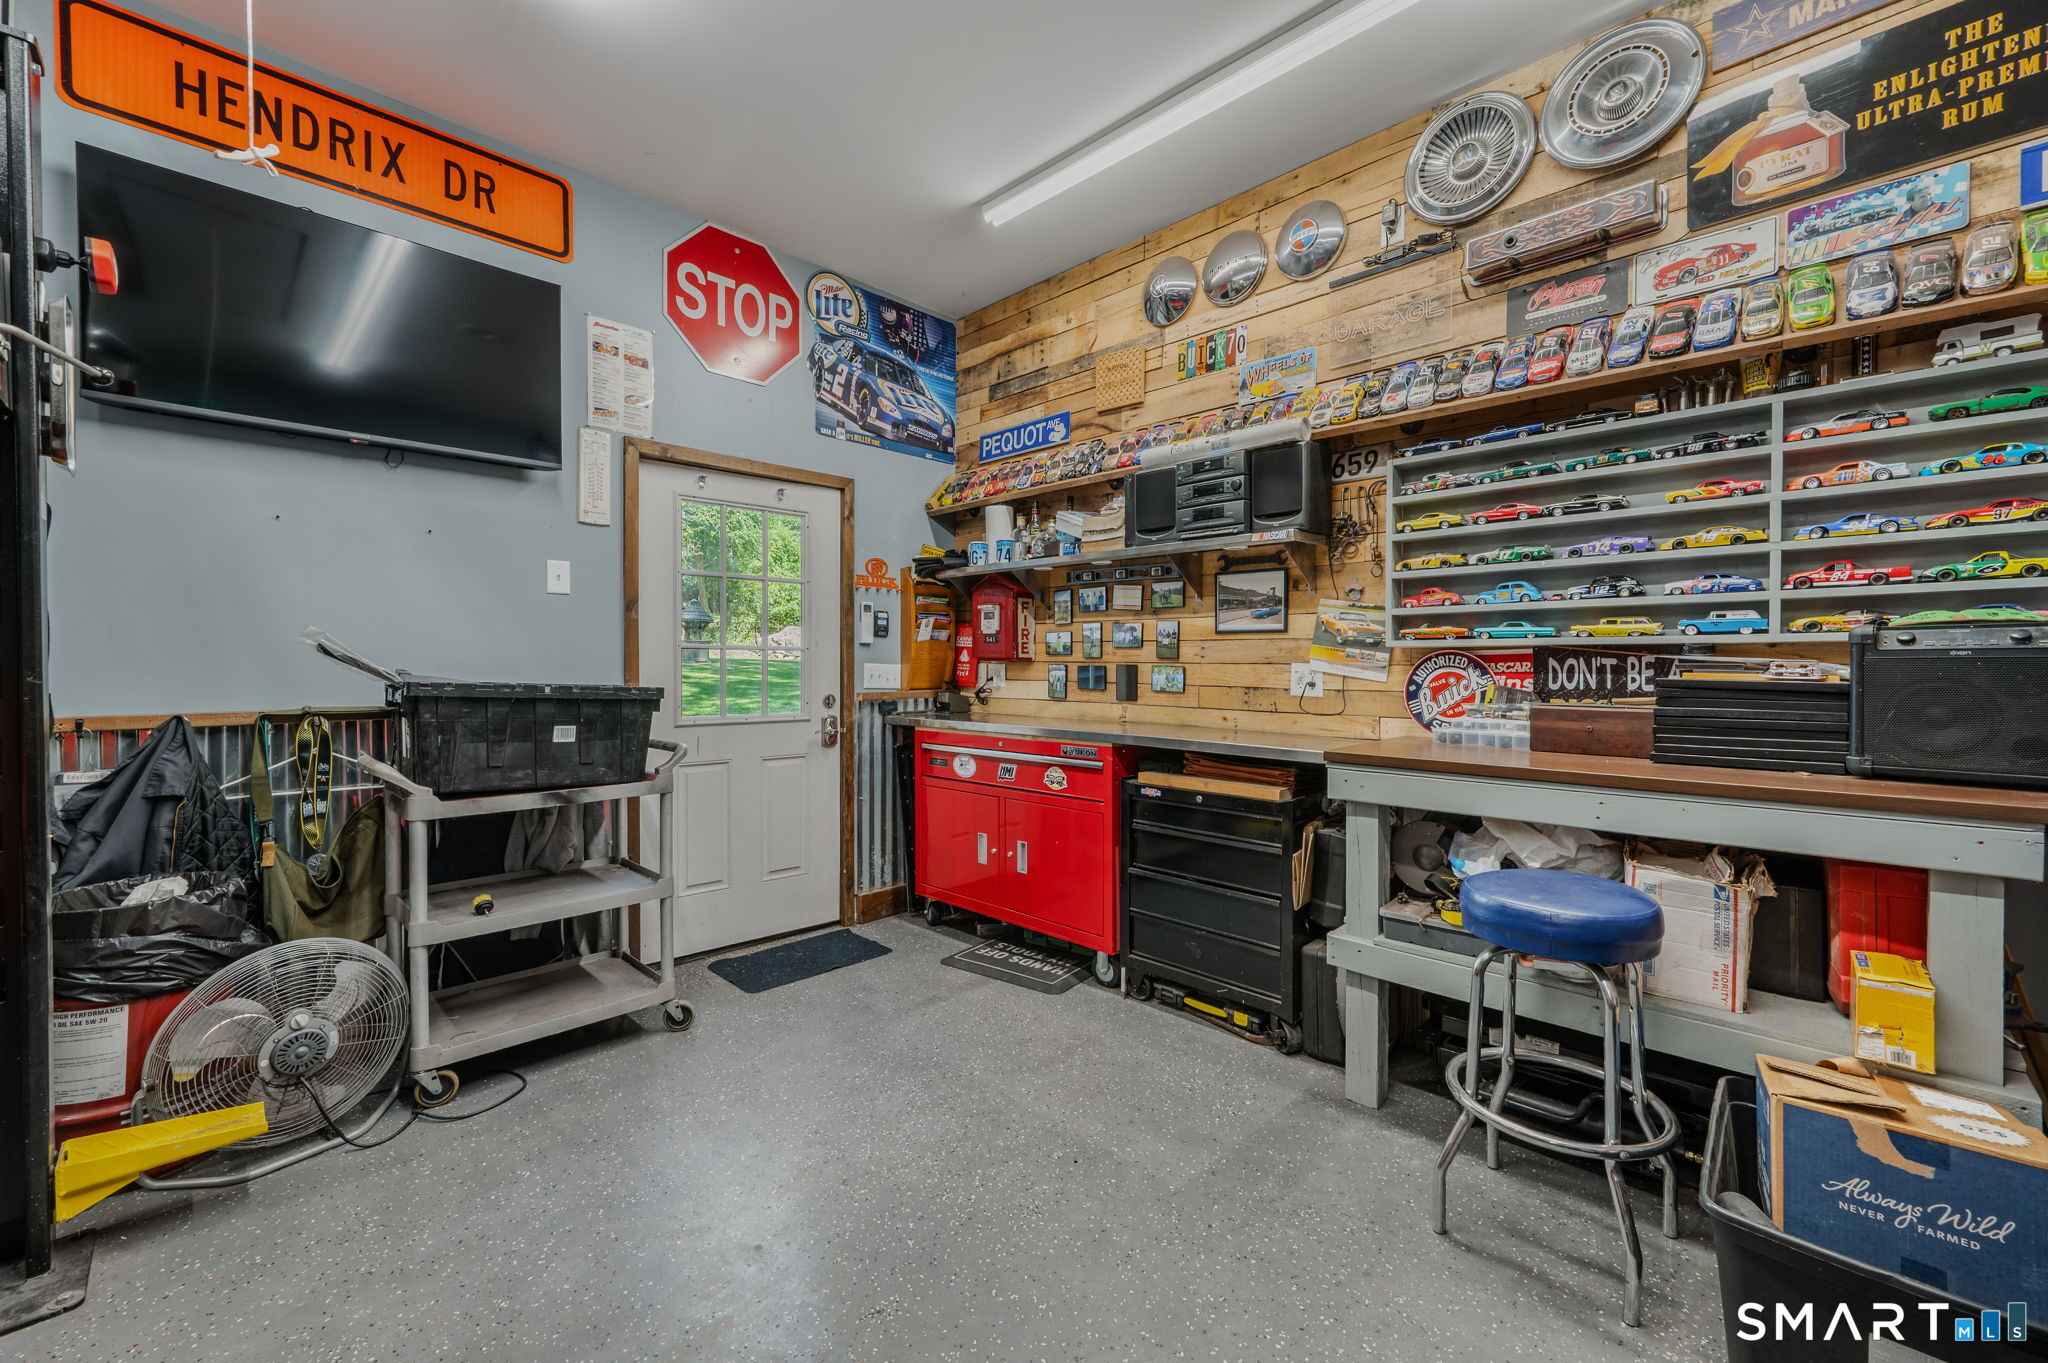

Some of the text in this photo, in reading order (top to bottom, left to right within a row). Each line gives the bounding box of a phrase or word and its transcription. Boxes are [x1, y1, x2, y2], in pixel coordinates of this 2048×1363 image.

[1789, 0, 1859, 28] MA
[1945, 12, 2004, 50] THE
[1873, 22, 2048, 101] ENLIGHTEN
[1856, 49, 2048, 131] ULTRA-PREM
[1942, 92, 2005, 130] RUM
[174, 60, 496, 214] HENDRIX DR
[1719, 253, 1730, 266] 11
[1968, 263, 2011, 278] Mobil
[1694, 274, 1715, 285] RED
[1908, 276, 1950, 291] QVC
[675, 262, 793, 342] STOP
[814, 289, 853, 321] Lite
[838, 323, 869, 340] Racing
[1334, 295, 1446, 342] GARAGE
[1697, 326, 1728, 337] GMAC
[1245, 352, 1313, 390] WHEELS OF
[1570, 351, 1597, 364] Mobil
[832, 363, 849, 400] 2
[982, 417, 1061, 457] PEQUOT AVE
[1332, 450, 1379, 479] 659
[1992, 507, 2015, 521] 97
[1263, 529, 1289, 541] NASCAR
[997, 547, 1011, 564] 74
[1829, 571, 1851, 582] 84
[1021, 601, 1030, 655] FIRE
[1412, 655, 1469, 684] AUTHORIZED
[1428, 678, 1447, 688] VALVE
[1548, 656, 1618, 691] DON'T
[1627, 656, 1656, 692] BE
[1418, 663, 1489, 723] Buick
[1070, 747, 1097, 757] YUKON
[1713, 901, 1721, 949] POSTAL SERVICE
[1723, 903, 1731, 925] UNITED
[974, 947, 1069, 976] HANDS OFF
[1712, 970, 1720, 991] MAIL
[1720, 963, 1729, 1005] PRIORITY
[70, 1006, 125, 1019] PERFORMANCE
[85, 1017, 108, 1025] 5W-20
[1821, 1177, 2016, 1244] Always Wild
[1838, 1200, 1981, 1251] NEVER FARMED
